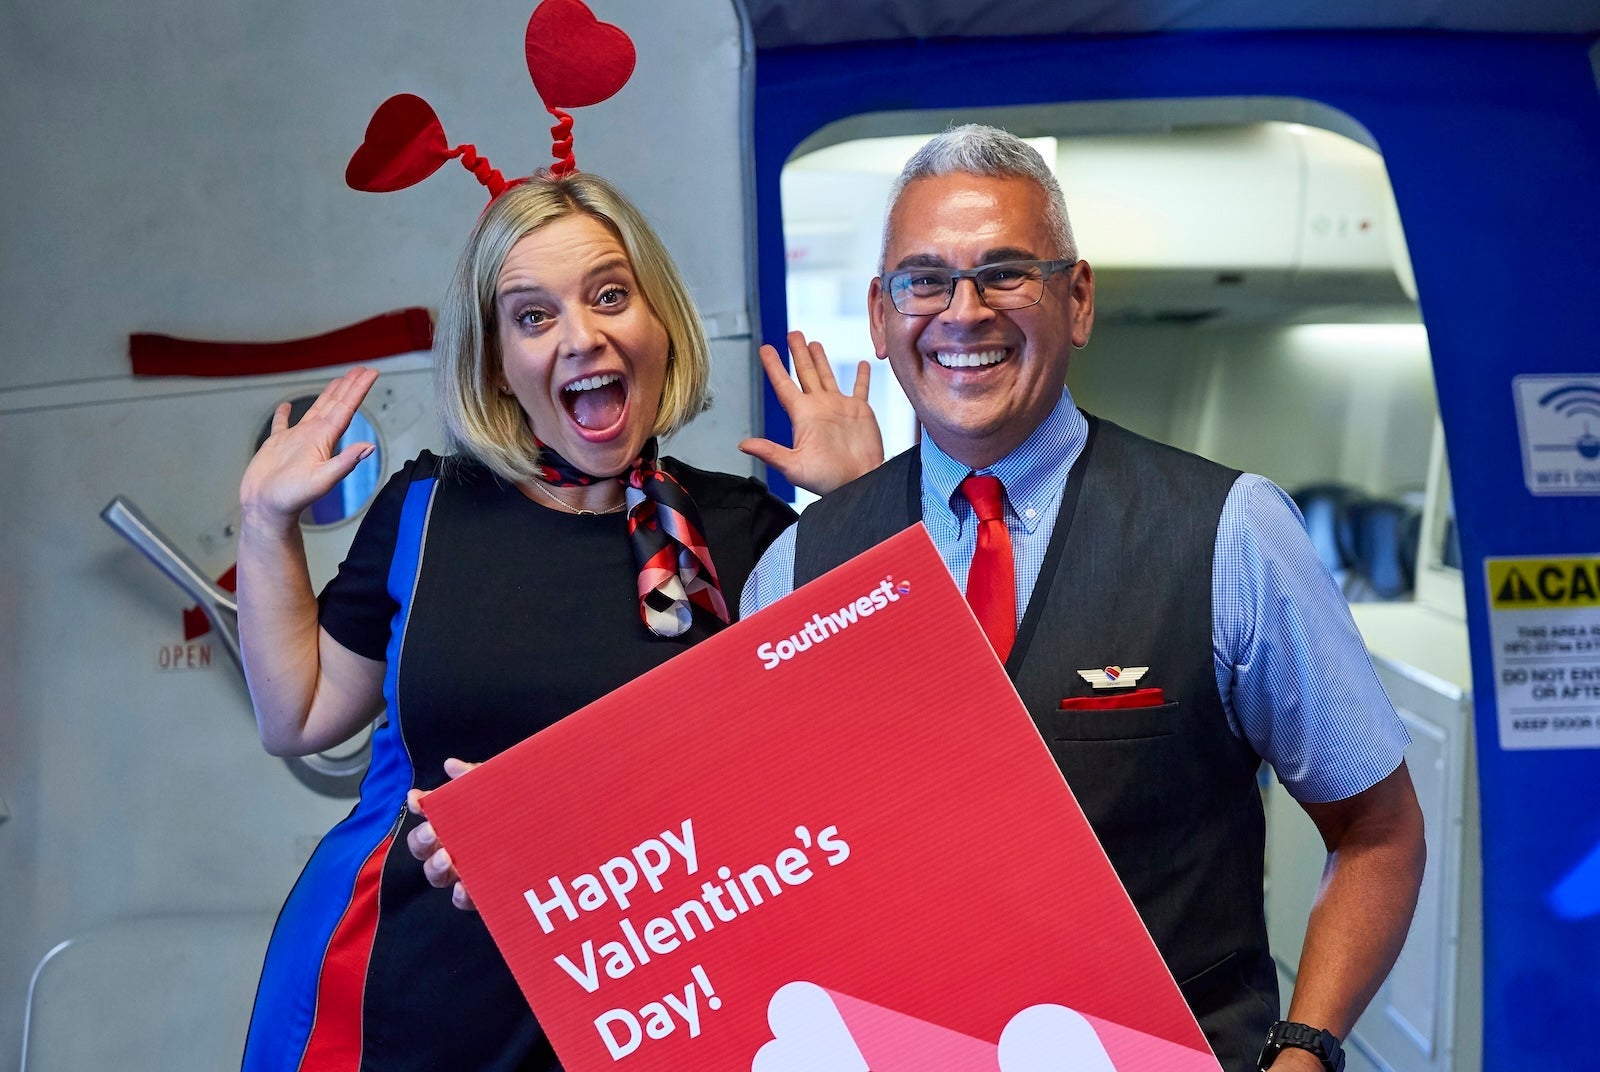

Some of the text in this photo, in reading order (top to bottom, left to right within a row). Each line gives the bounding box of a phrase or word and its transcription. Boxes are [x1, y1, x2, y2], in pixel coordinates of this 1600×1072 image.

[1536, 564, 1600, 602] CA
[756, 578, 900, 670] Southwest
[1551, 625, 1587, 638] AREA
[158, 644, 212, 668] OPEN
[1502, 668, 1528, 686] DO
[1531, 667, 1564, 684] NOT
[1532, 685, 1557, 702] OR
[1512, 718, 1548, 731] KEEP
[1552, 716, 1592, 730] DOOR
[523, 817, 699, 935] Happy
[553, 824, 851, 994] Valentine's
[593, 964, 722, 1062] Day!
